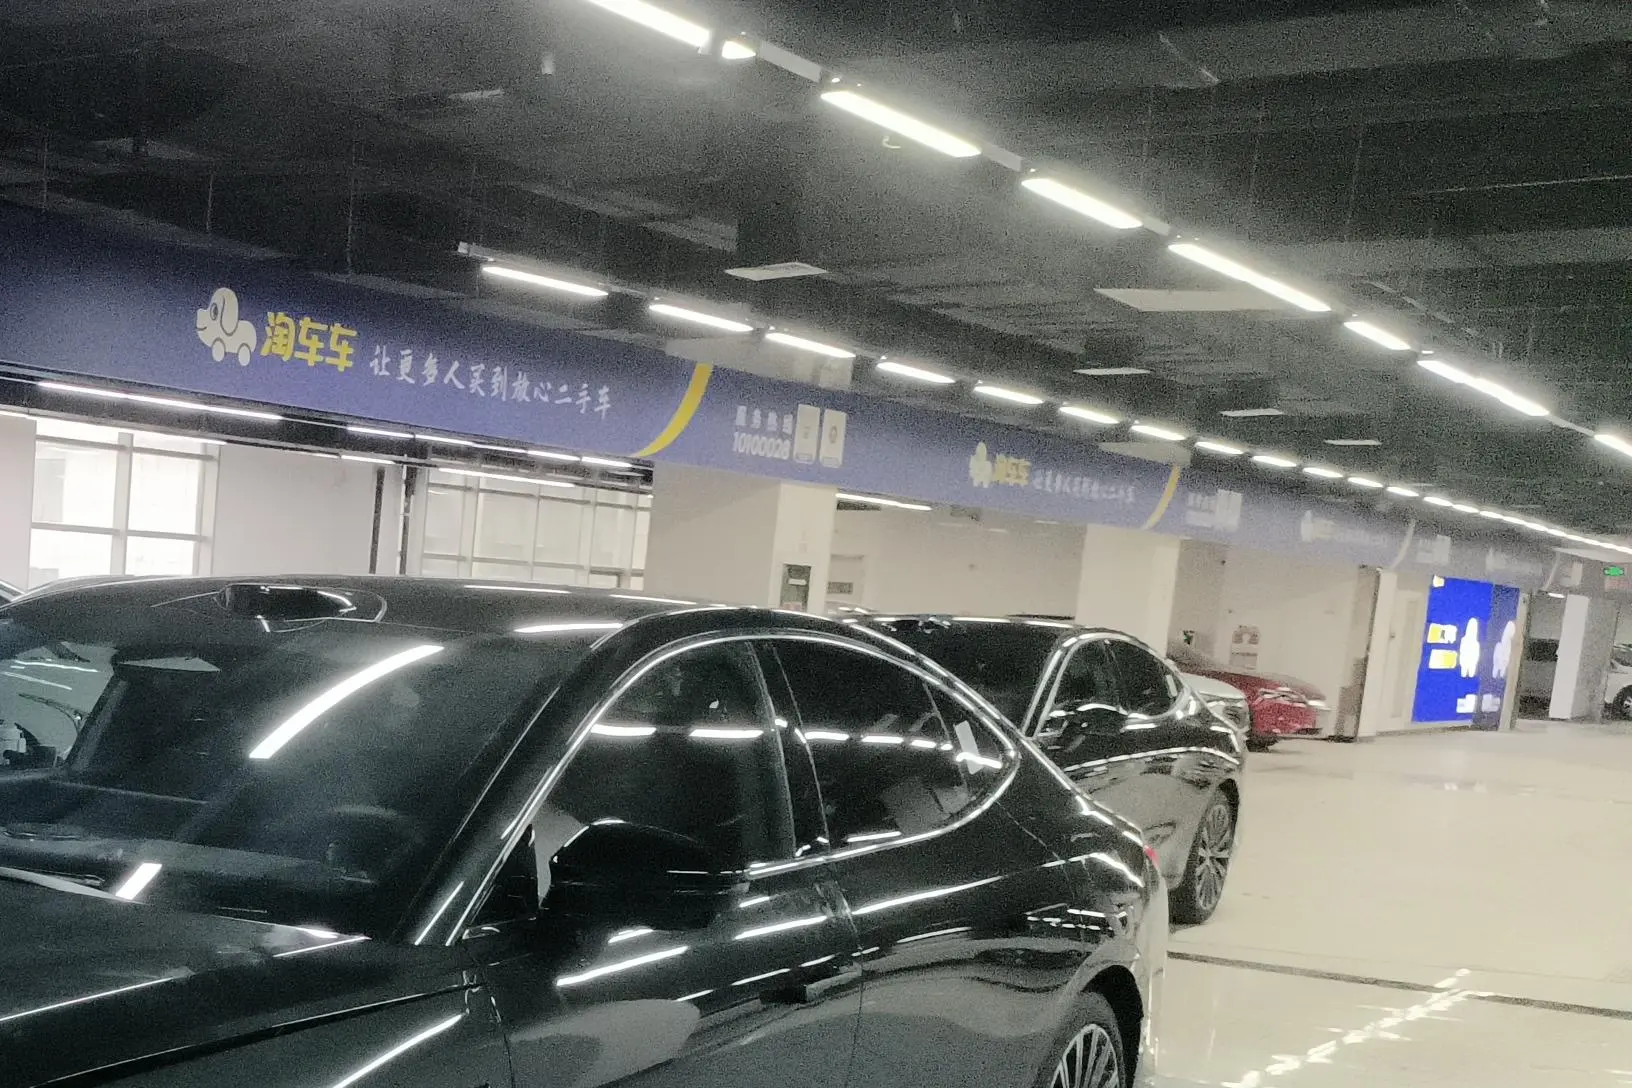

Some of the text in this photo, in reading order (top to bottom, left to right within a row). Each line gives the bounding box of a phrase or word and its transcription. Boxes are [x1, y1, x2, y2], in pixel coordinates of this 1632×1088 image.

[260, 311, 358, 373] 淘车车
[369, 344, 612, 420] 让更多人买到放心二手车
